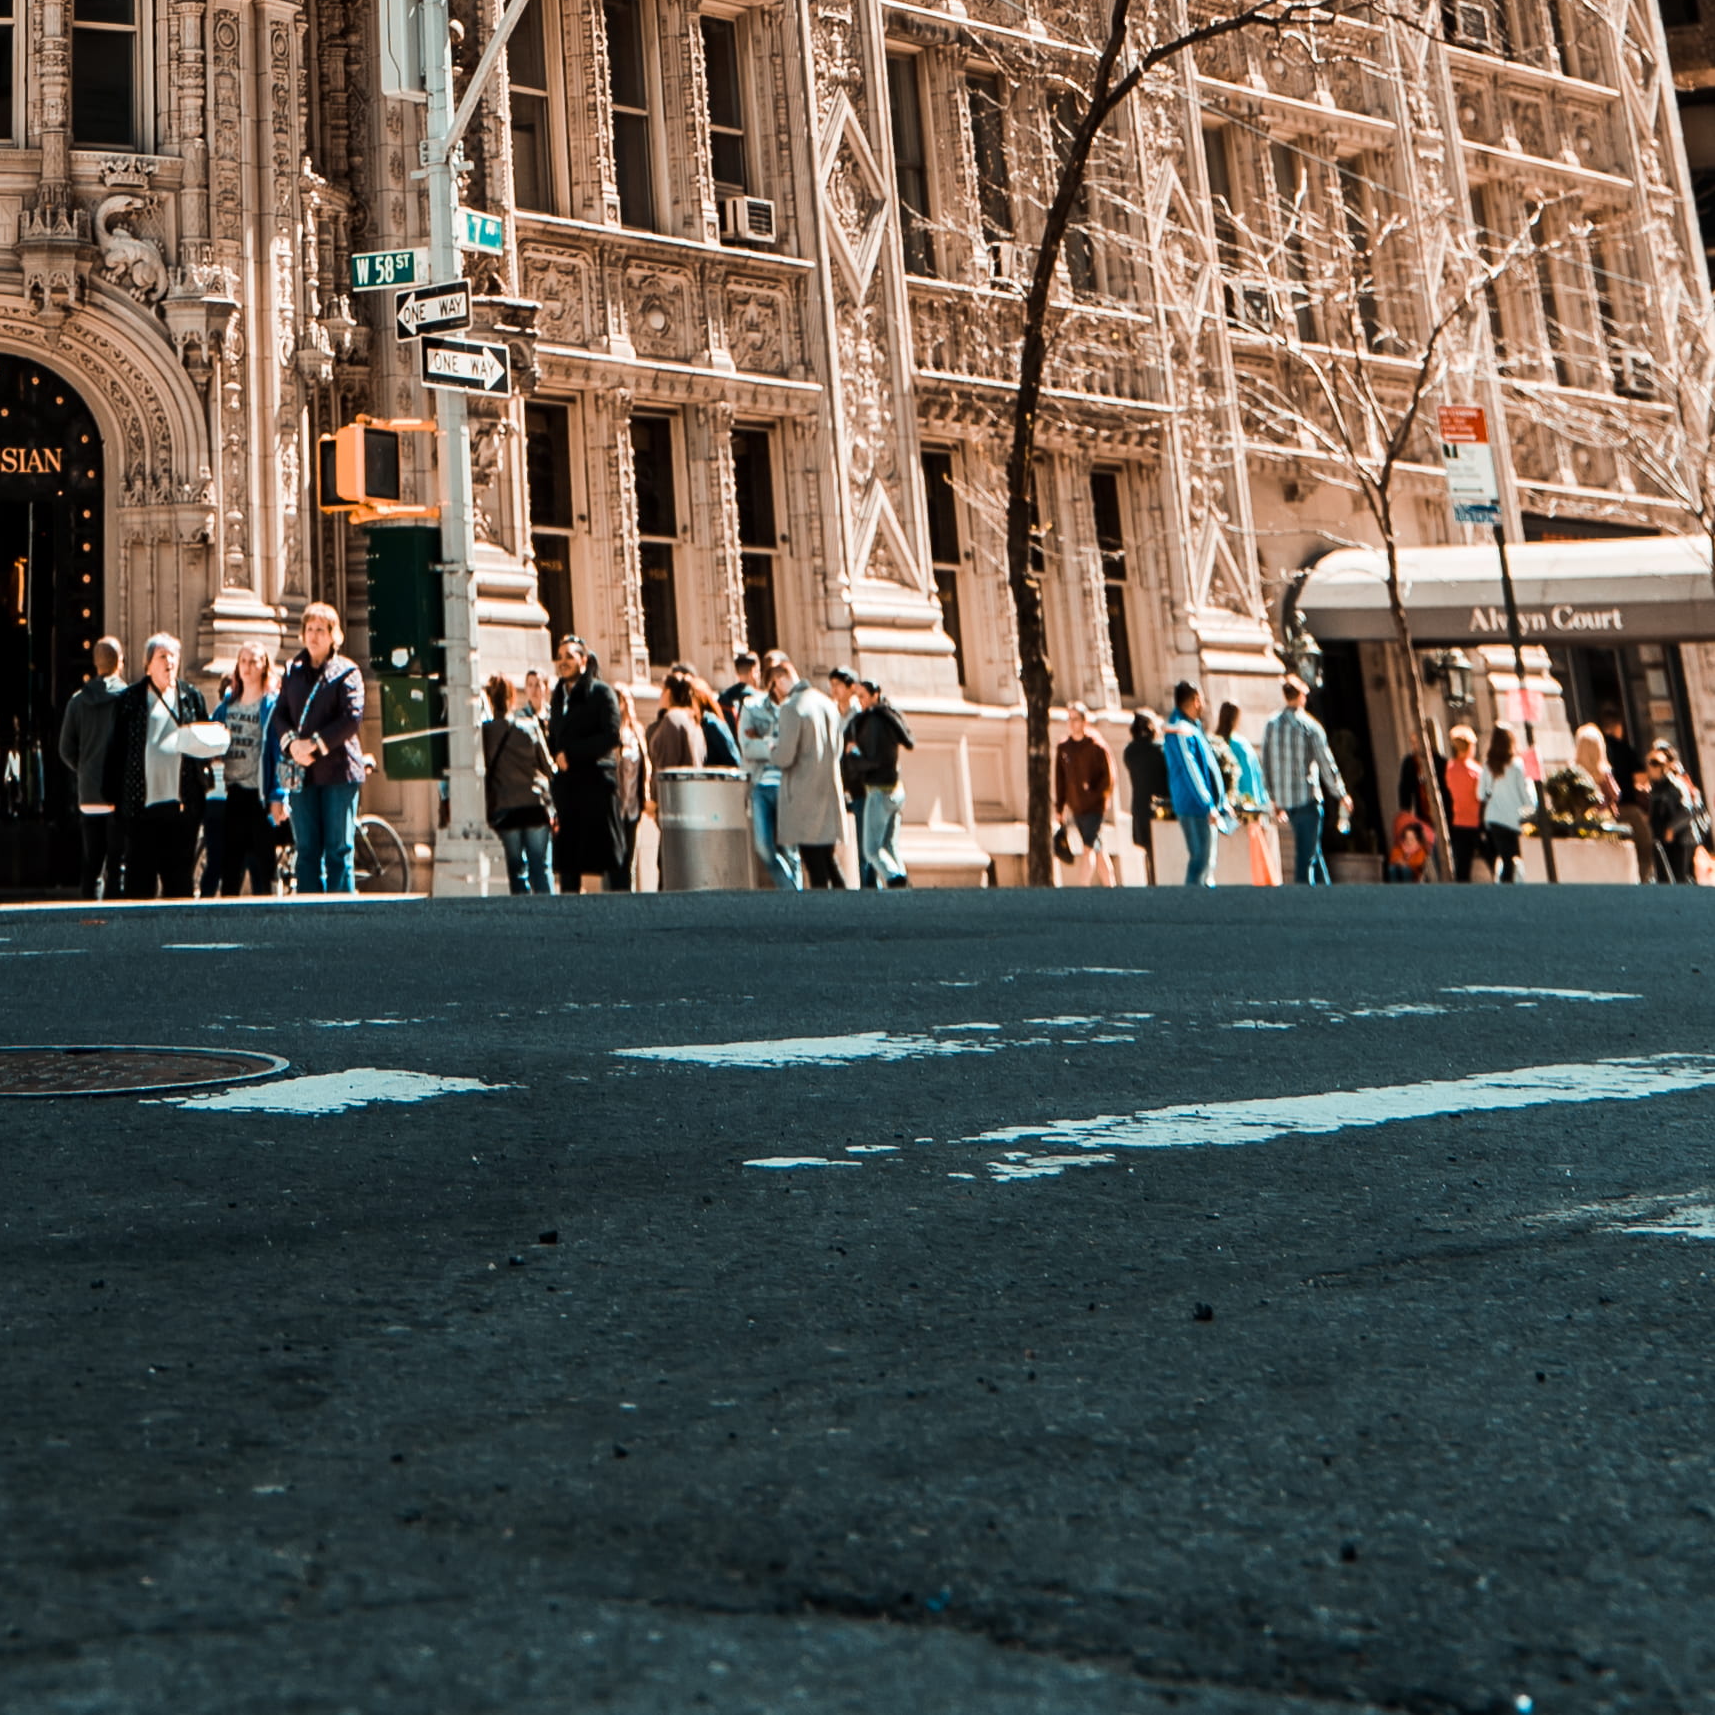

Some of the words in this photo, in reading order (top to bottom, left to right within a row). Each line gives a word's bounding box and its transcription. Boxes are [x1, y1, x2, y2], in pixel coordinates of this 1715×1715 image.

[471, 216, 482, 244] 7
[356, 257, 369, 285] W
[375, 255, 394, 284] 58
[395, 253, 410, 269] ST
[403, 303, 426, 323] ONE
[439, 296, 462, 317] WAY
[434, 352, 458, 373] ONE
[470, 357, 495, 378] WAY
[1551, 603, 1623, 631] Court
